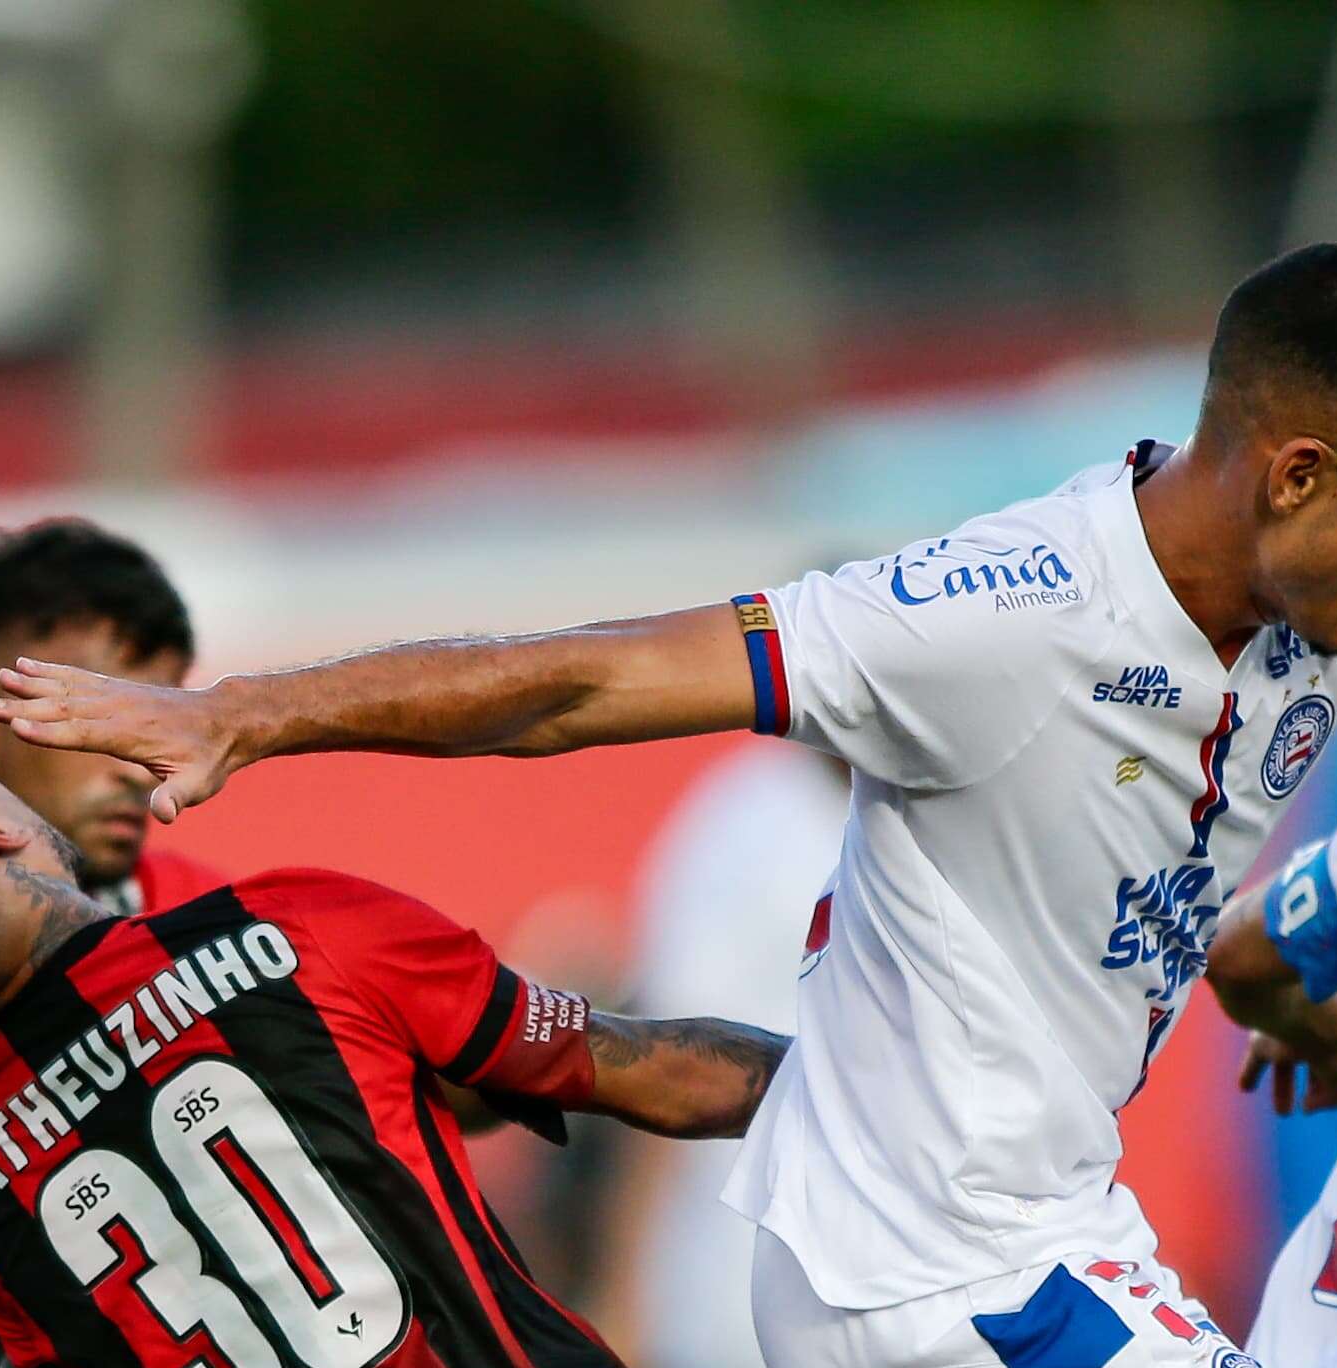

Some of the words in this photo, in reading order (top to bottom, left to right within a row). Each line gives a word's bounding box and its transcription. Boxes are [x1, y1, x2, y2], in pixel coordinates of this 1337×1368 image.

[1092, 682, 1183, 709] SORTE
[538, 1021, 554, 1043] DA
[169, 1086, 220, 1133] SBS
[65, 1173, 110, 1221] SBS
